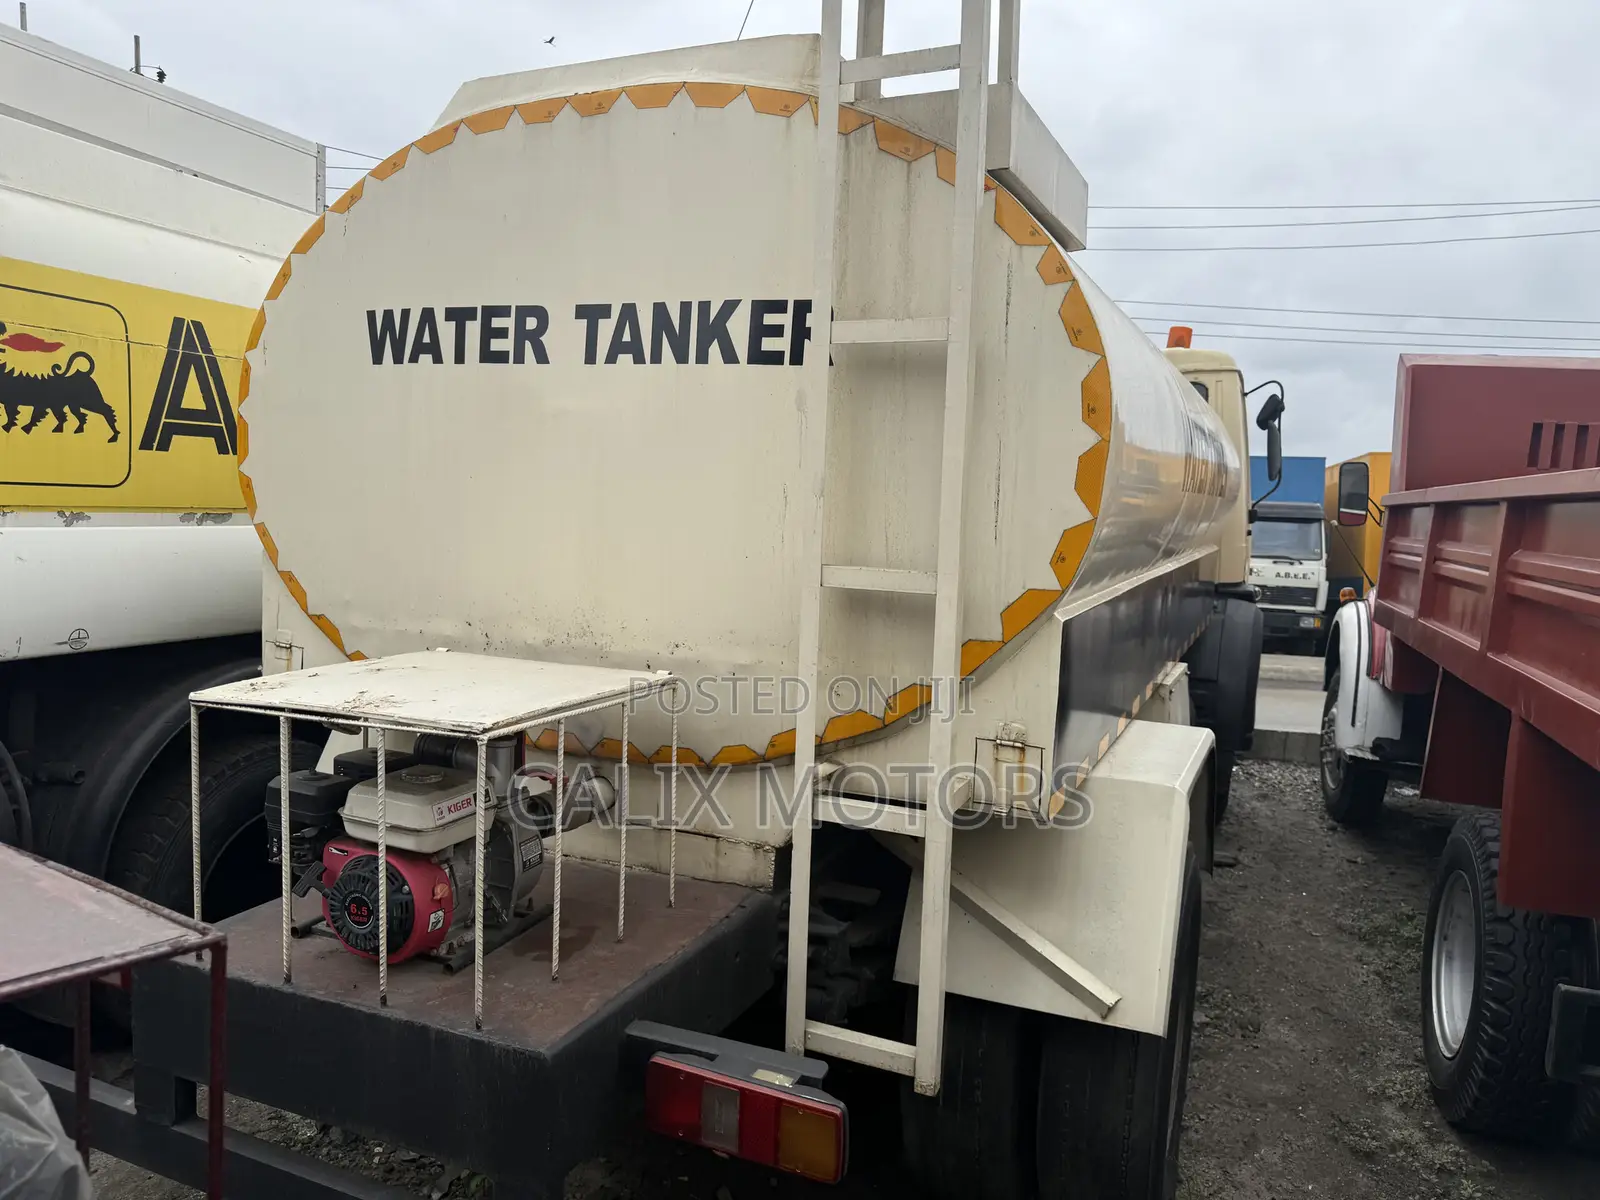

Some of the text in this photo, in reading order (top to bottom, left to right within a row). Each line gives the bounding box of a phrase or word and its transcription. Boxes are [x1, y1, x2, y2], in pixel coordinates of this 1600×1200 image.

[366, 305, 550, 365] WATER
[447, 797, 473, 815] KIGER
[350, 903, 368, 916] 6.5
